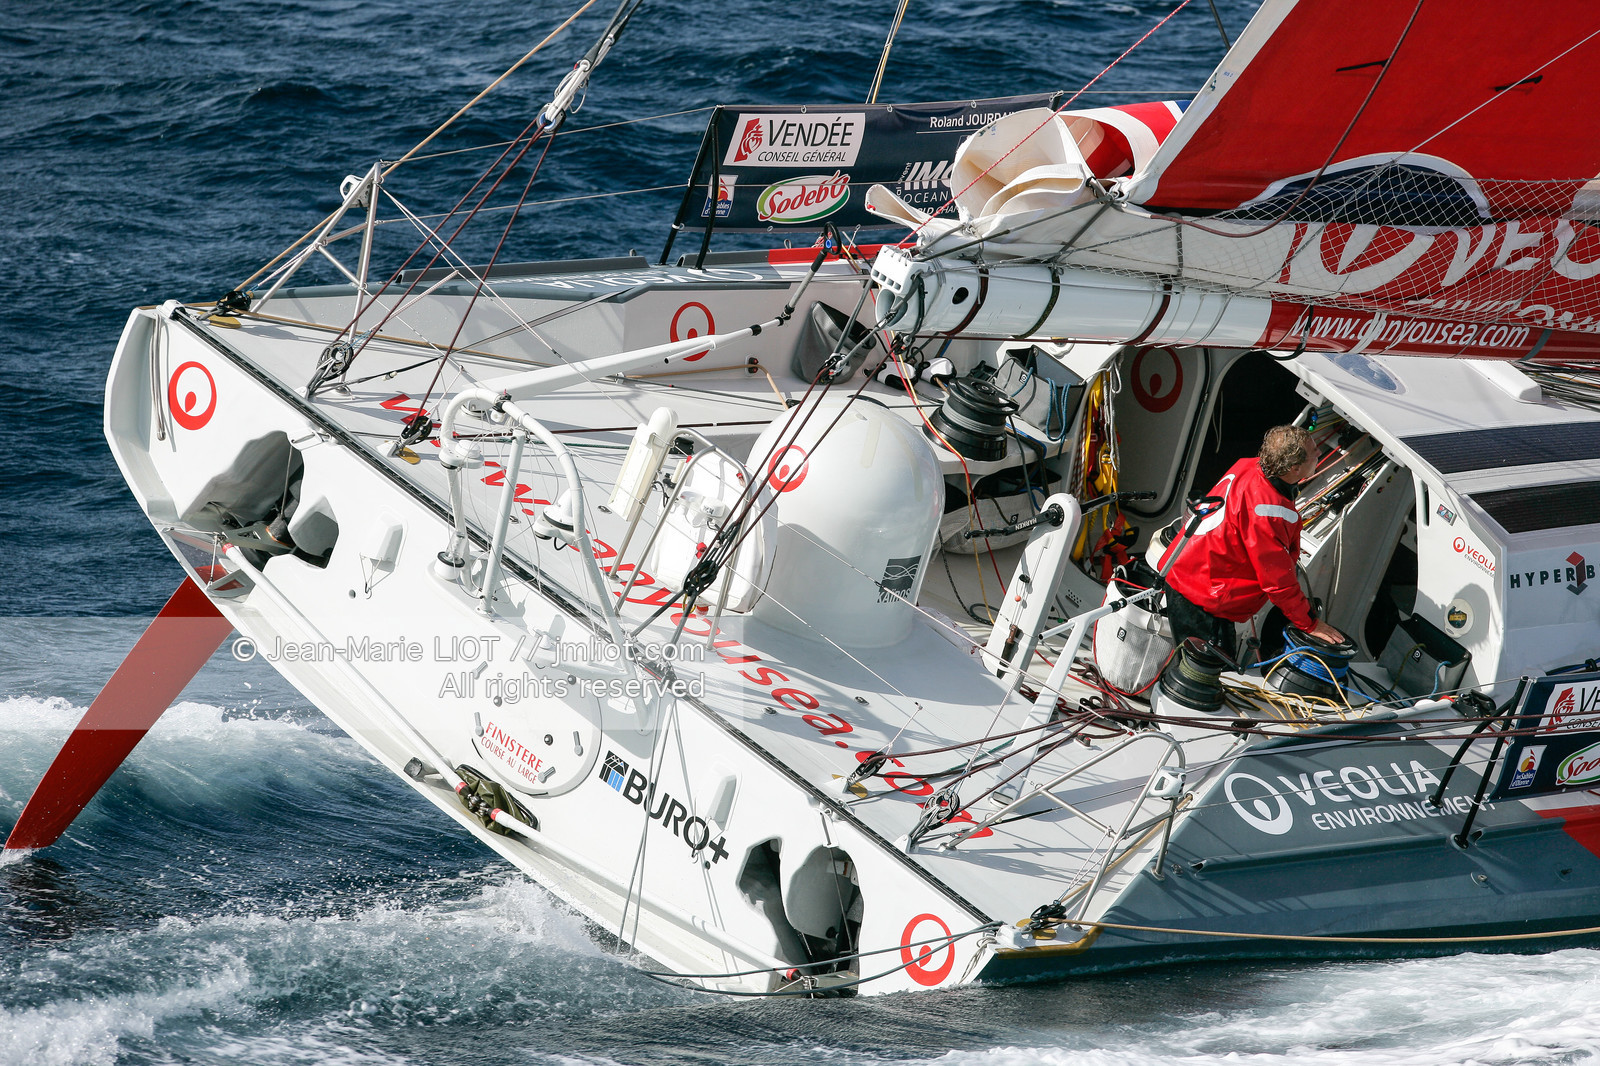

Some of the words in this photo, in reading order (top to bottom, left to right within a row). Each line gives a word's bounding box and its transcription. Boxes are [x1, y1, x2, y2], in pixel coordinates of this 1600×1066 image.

[768, 116, 855, 147] VENDÉE
[930, 116, 964, 128] Roland
[757, 151, 799, 163] CONSEIL
[802, 149, 847, 163] GÉNÉRAL
[903, 190, 949, 204] OCEAN
[481, 736, 506, 760] COURSE
[506, 756, 517, 768] AU
[517, 764, 537, 785] LARGE
[486, 721, 543, 773] FINISTERE
[1277, 760, 1449, 806] VEOLIA
[622, 768, 730, 864] BURO+
